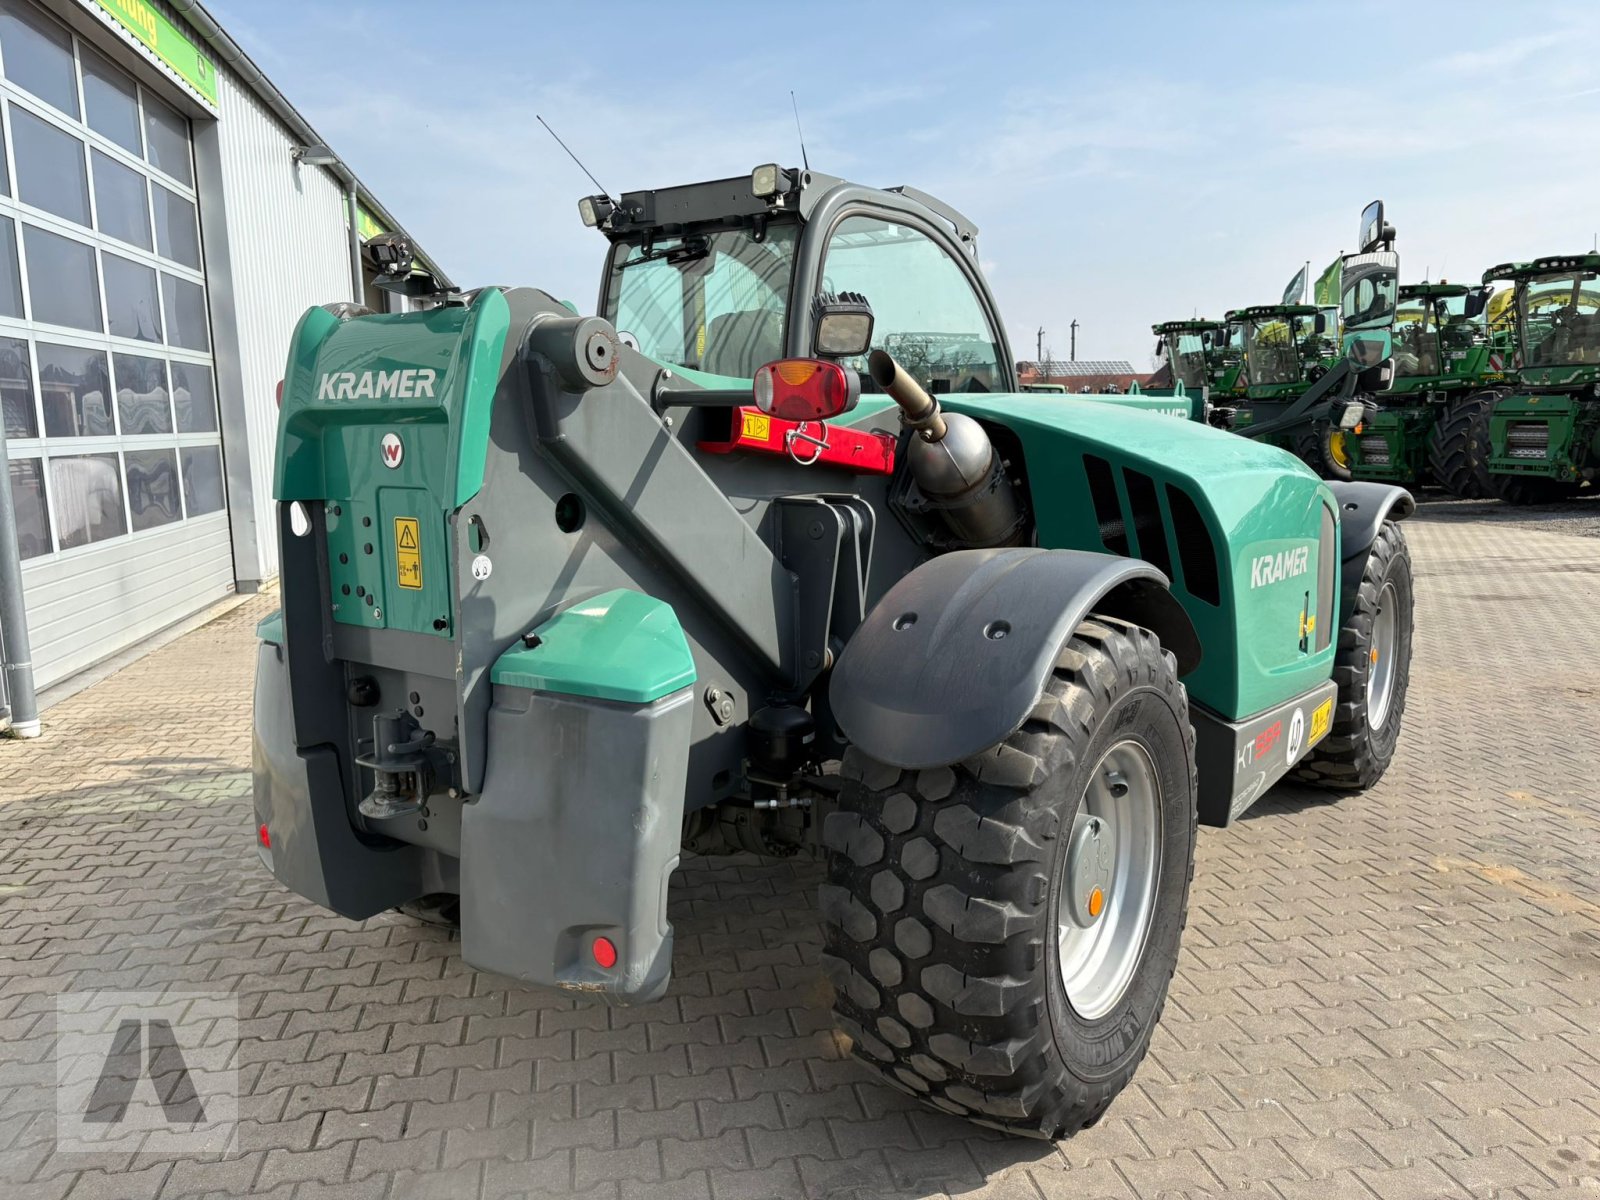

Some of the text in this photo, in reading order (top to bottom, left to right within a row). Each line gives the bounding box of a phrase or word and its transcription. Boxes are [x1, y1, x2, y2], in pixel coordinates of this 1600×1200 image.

[117, 0, 158, 47] ung
[318, 369, 436, 400] KRAMER
[1148, 408, 1188, 419] AMER
[1250, 545, 1309, 590] KRAMER
[1289, 717, 1301, 753] 40
